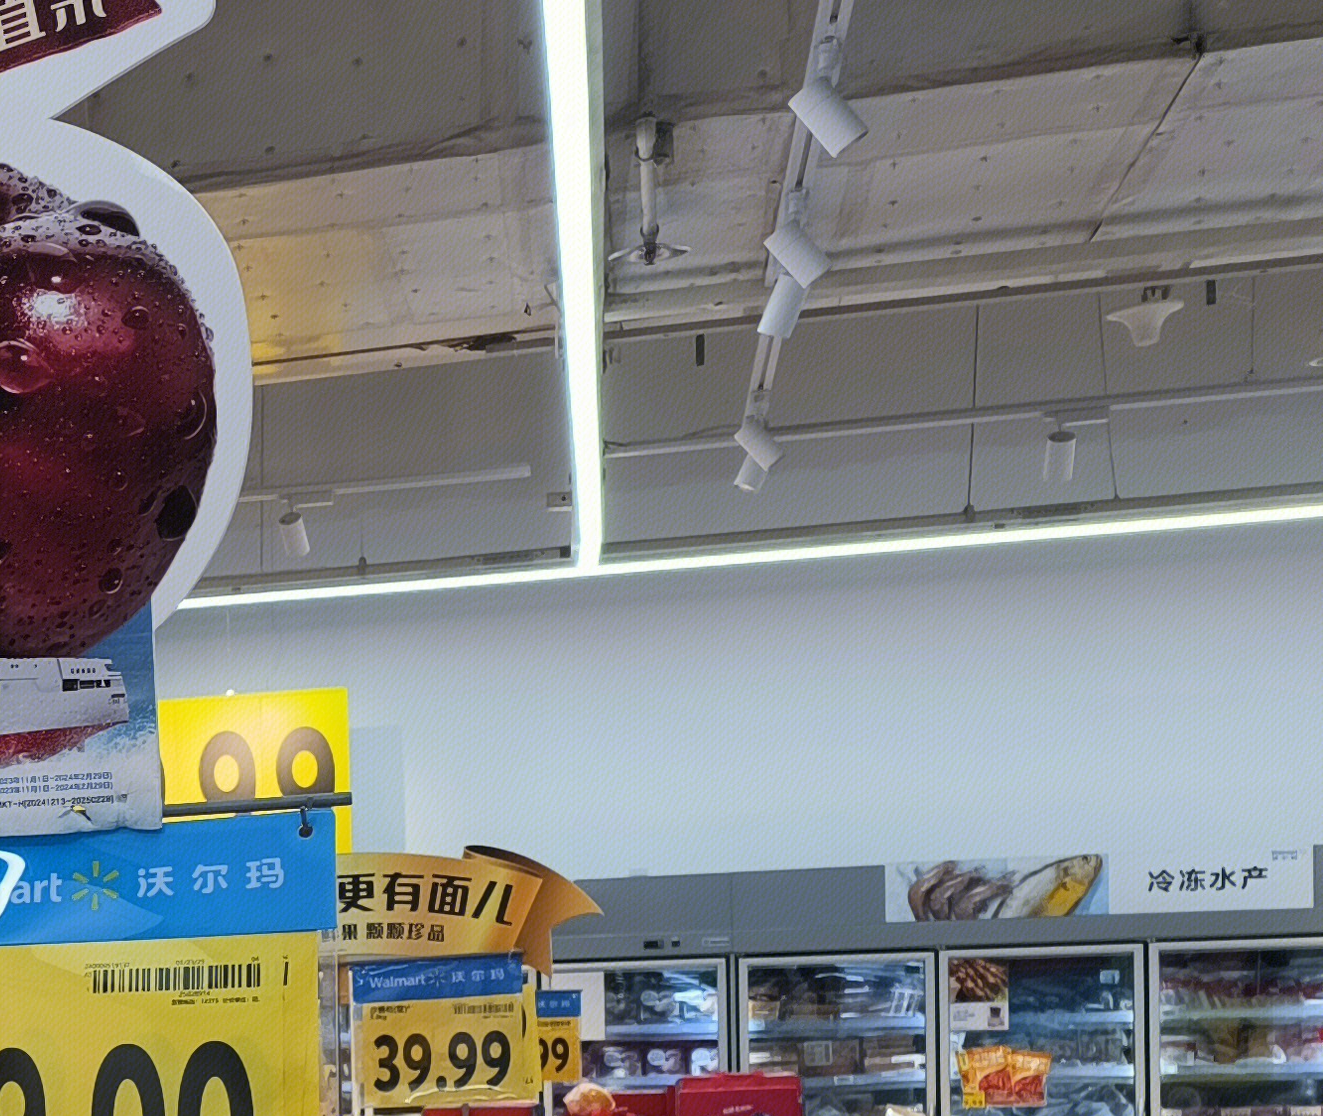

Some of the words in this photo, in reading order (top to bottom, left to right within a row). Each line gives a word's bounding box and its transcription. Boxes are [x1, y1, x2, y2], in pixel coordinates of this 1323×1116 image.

[136, 857, 285, 897] 沃尔玛
[1148, 866, 1268, 893] 冷冻水产
[369, 973, 427, 989] Walmart
[373, 1030, 511, 1093] 39.99
